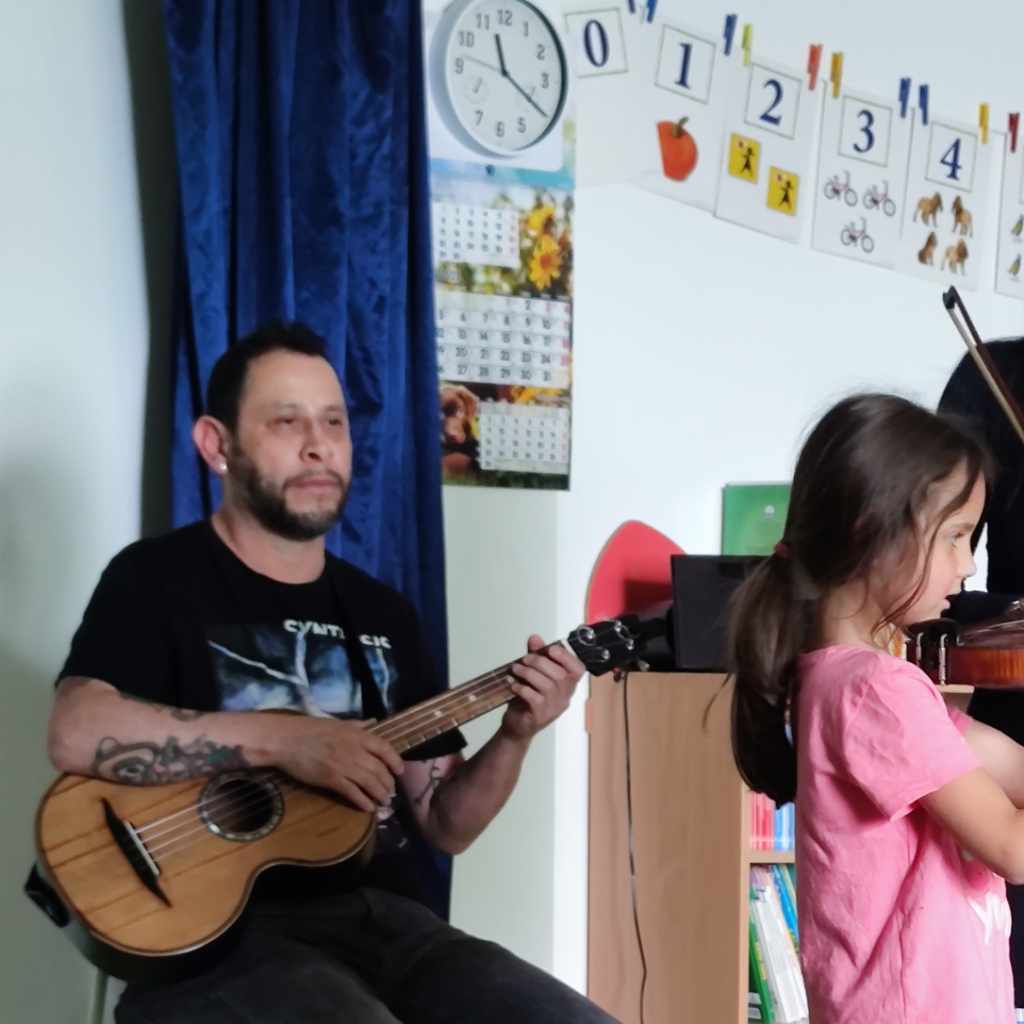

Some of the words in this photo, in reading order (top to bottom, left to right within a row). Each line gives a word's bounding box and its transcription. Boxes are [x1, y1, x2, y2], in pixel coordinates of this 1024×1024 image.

[476, 13, 490, 30] 11
[497, 9, 513, 26] 12
[458, 31, 474, 48] 10
[582, 18, 609, 68] 0
[536, 44, 545, 60] 2
[674, 42, 693, 90] 1
[541, 72, 550, 88] 3
[758, 78, 784, 126] 2
[475, 110, 484, 126] 7
[517, 117, 527, 134] 5
[853, 109, 876, 154] 3
[940, 138, 962, 182] 4
